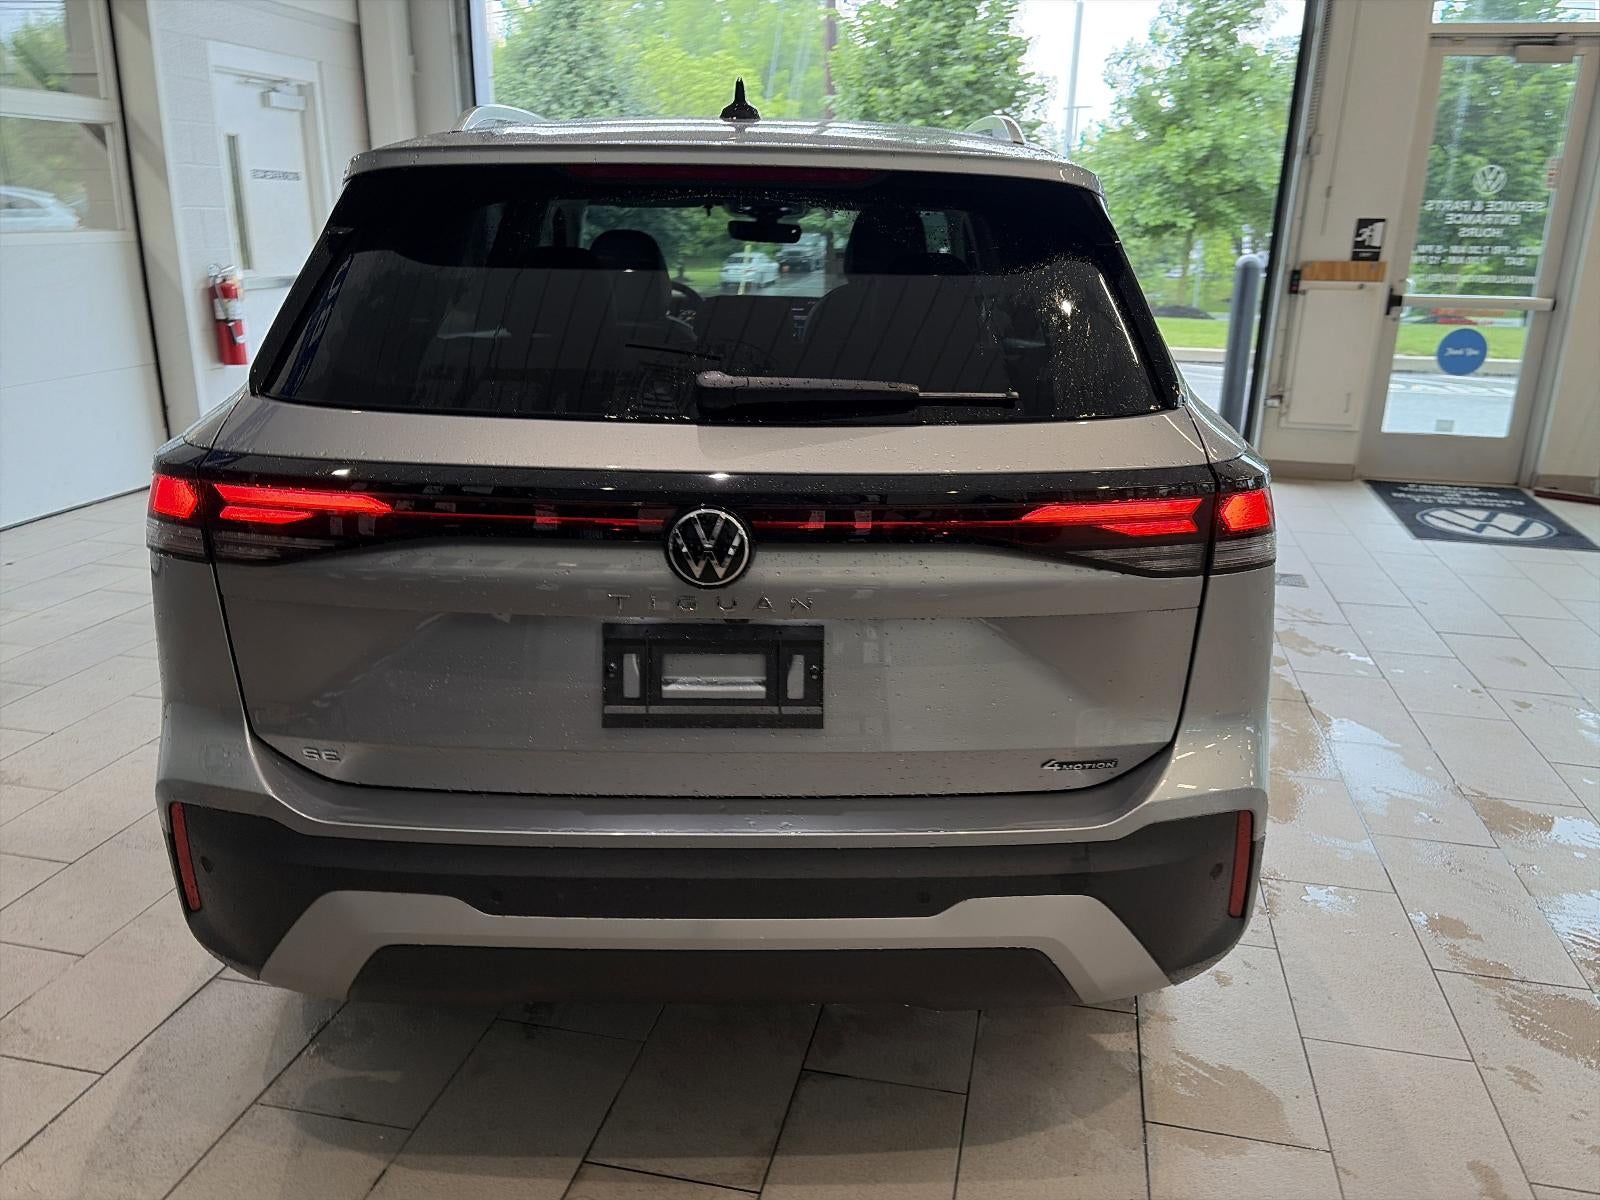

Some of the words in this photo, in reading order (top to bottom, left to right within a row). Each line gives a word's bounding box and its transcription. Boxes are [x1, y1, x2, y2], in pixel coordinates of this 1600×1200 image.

[607, 592, 815, 612] TIGUAN
[302, 747, 341, 763] SE
[1041, 759, 1118, 771] 4MOTION
